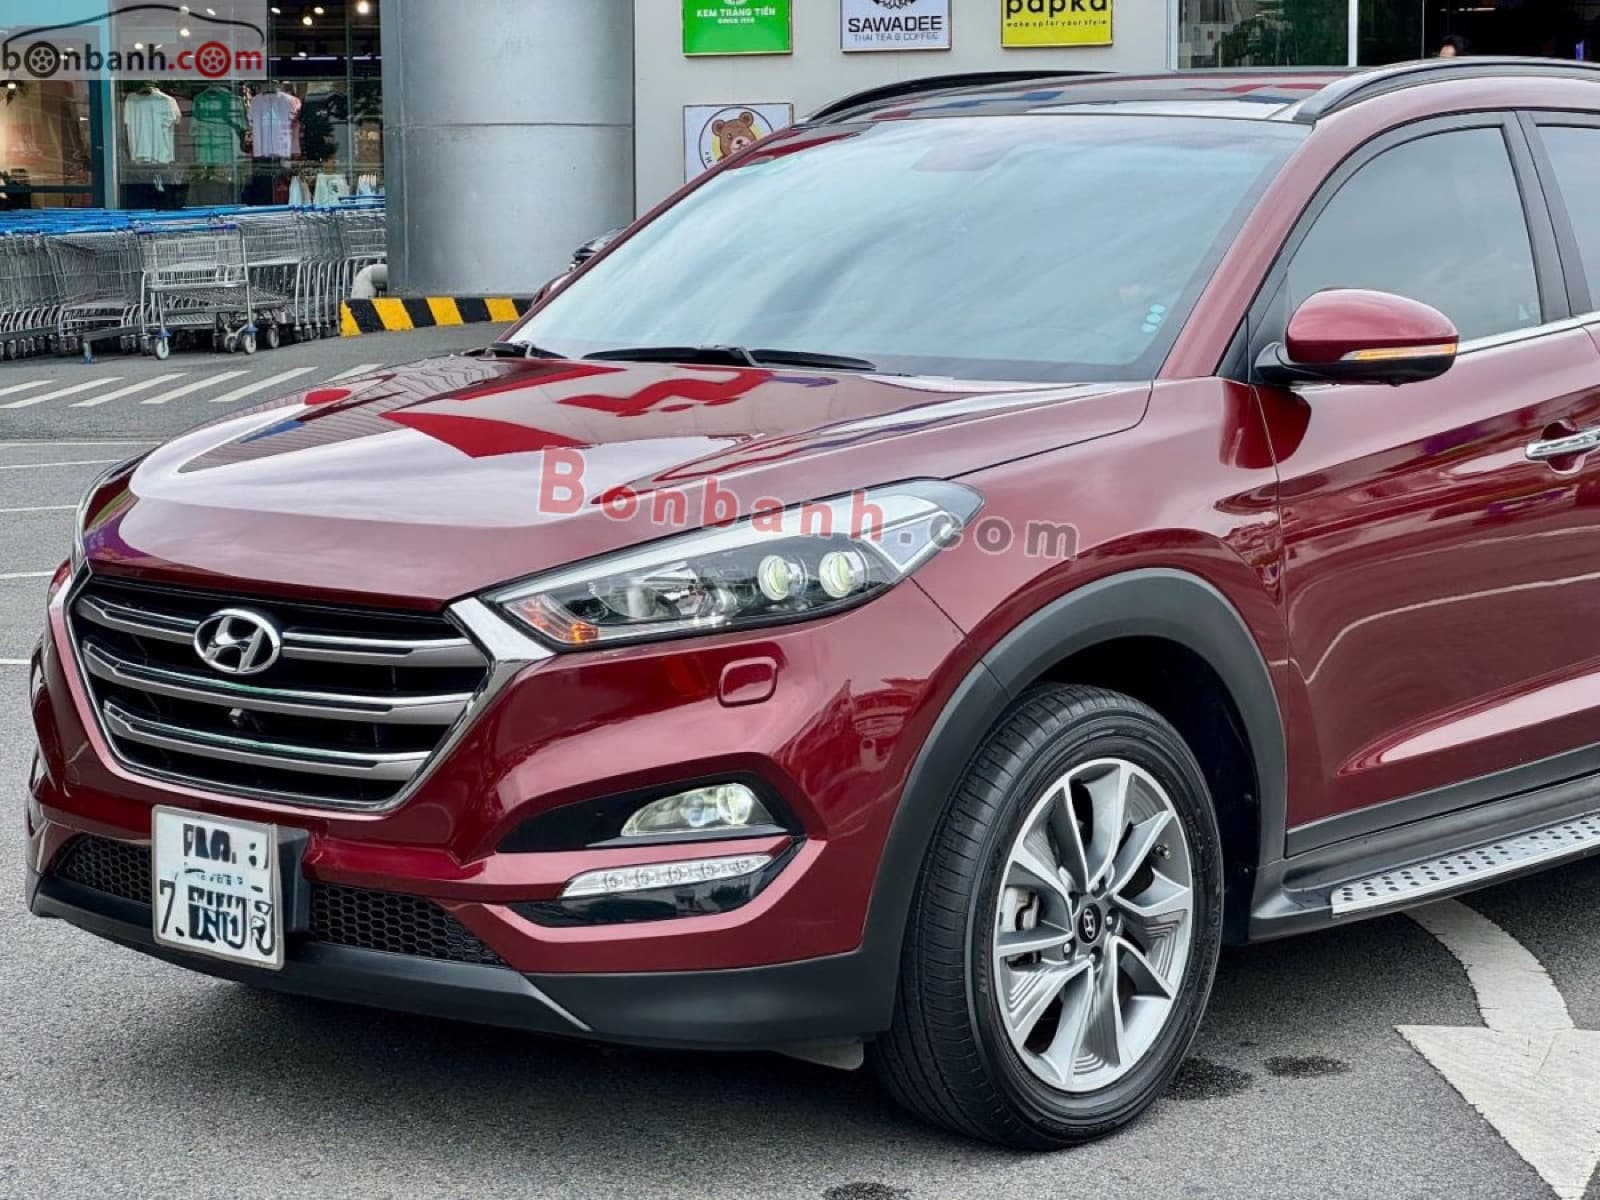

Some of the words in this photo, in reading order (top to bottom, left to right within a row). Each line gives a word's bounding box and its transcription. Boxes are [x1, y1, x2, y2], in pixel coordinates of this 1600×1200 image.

[696, 8, 717, 17] KEM
[1006, 0, 1107, 19] papka
[848, 16, 943, 33] SAWADEE
[876, 33, 892, 41] TEA
[903, 32, 940, 40] COFFEE
